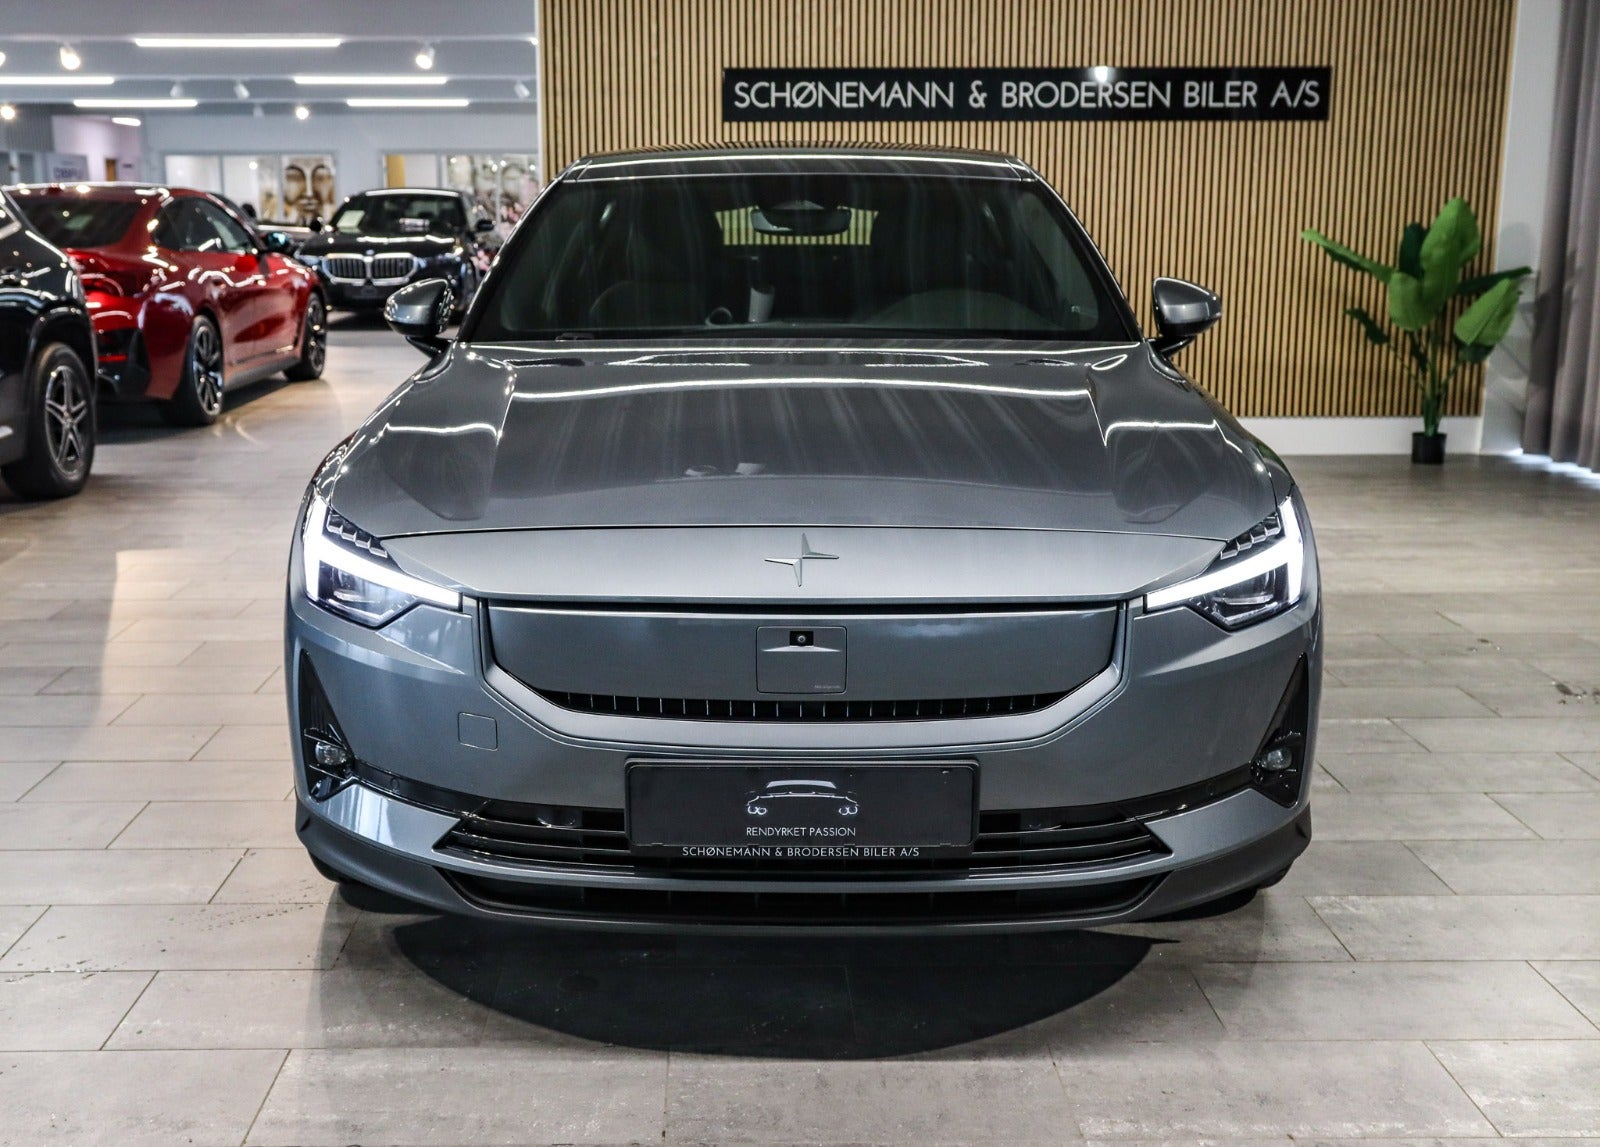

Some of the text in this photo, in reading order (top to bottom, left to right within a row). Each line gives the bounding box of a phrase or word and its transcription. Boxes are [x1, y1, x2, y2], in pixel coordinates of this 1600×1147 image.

[734, 79, 1320, 108] SCHØNEMANN & BRODERSEN BILER A/S
[746, 827, 856, 837] RENDYRKET PASSION
[682, 846, 920, 857] SCHØNEMANN & BRODERSEN BILER A/S
